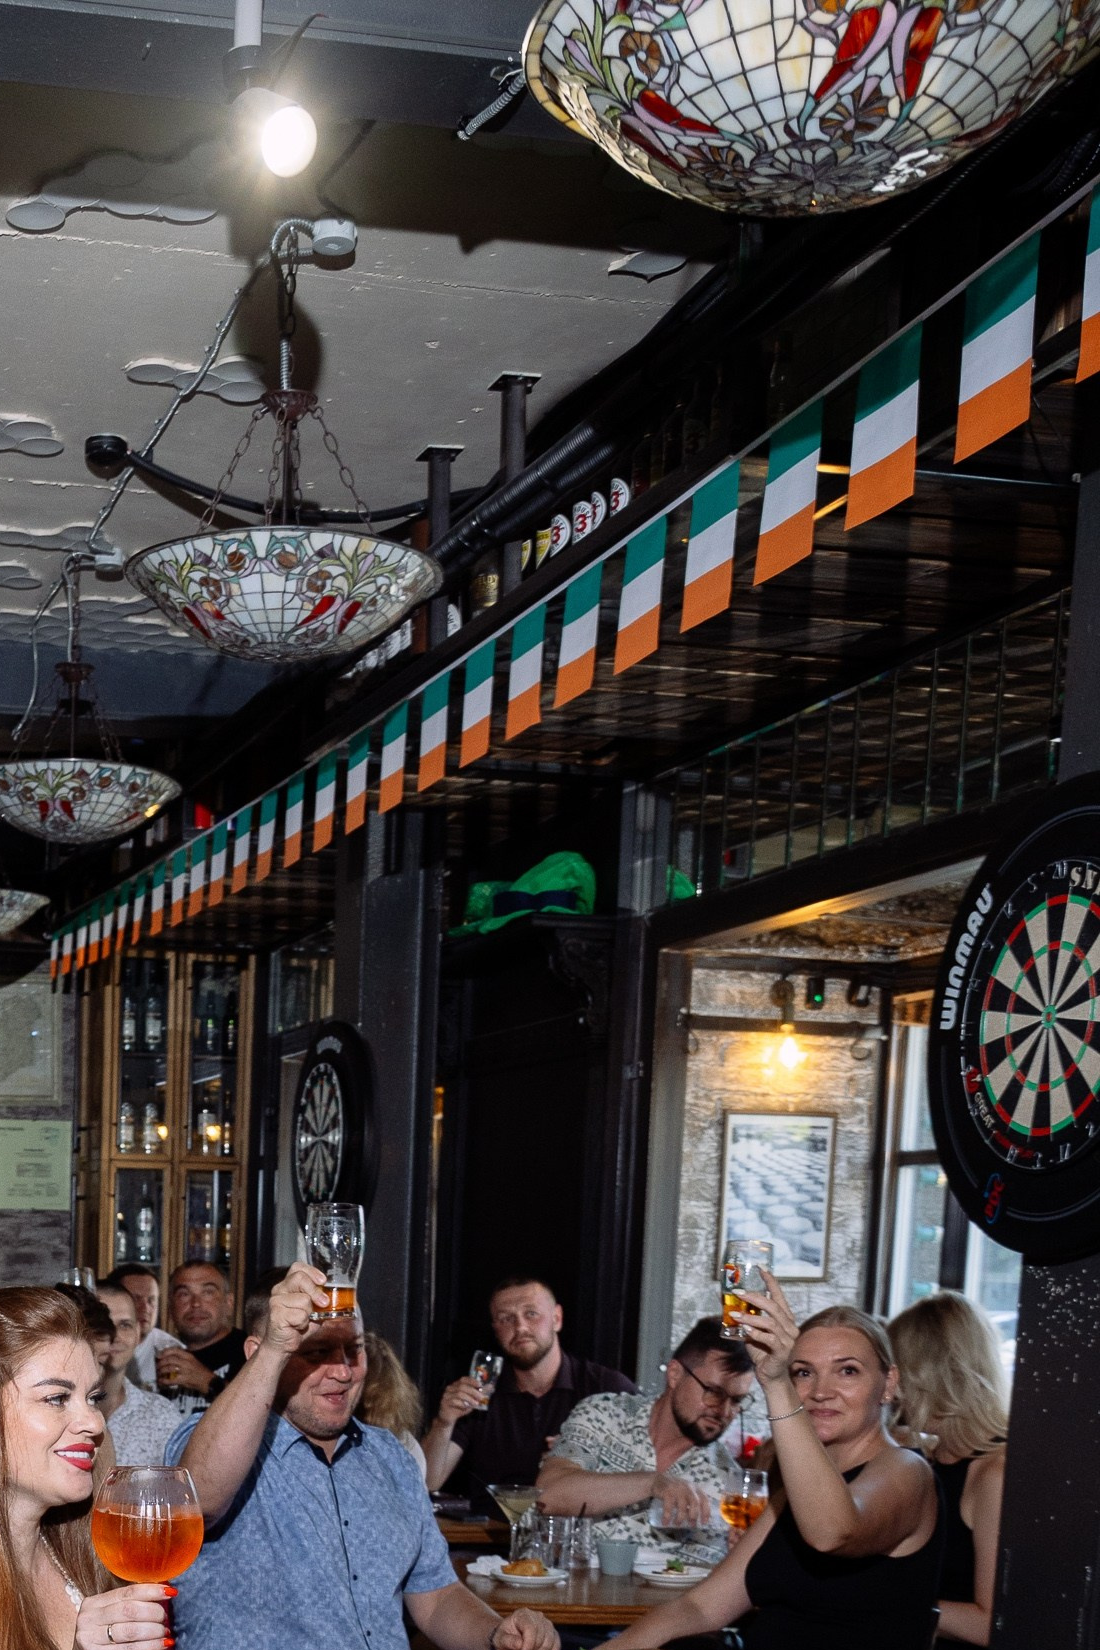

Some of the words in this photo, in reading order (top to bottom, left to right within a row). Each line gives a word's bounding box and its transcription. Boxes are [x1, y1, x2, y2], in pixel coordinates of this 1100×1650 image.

[575, 513, 587, 532] 3
[940, 882, 994, 1030] WINMAU
[974, 1092, 996, 1129] GREAT
